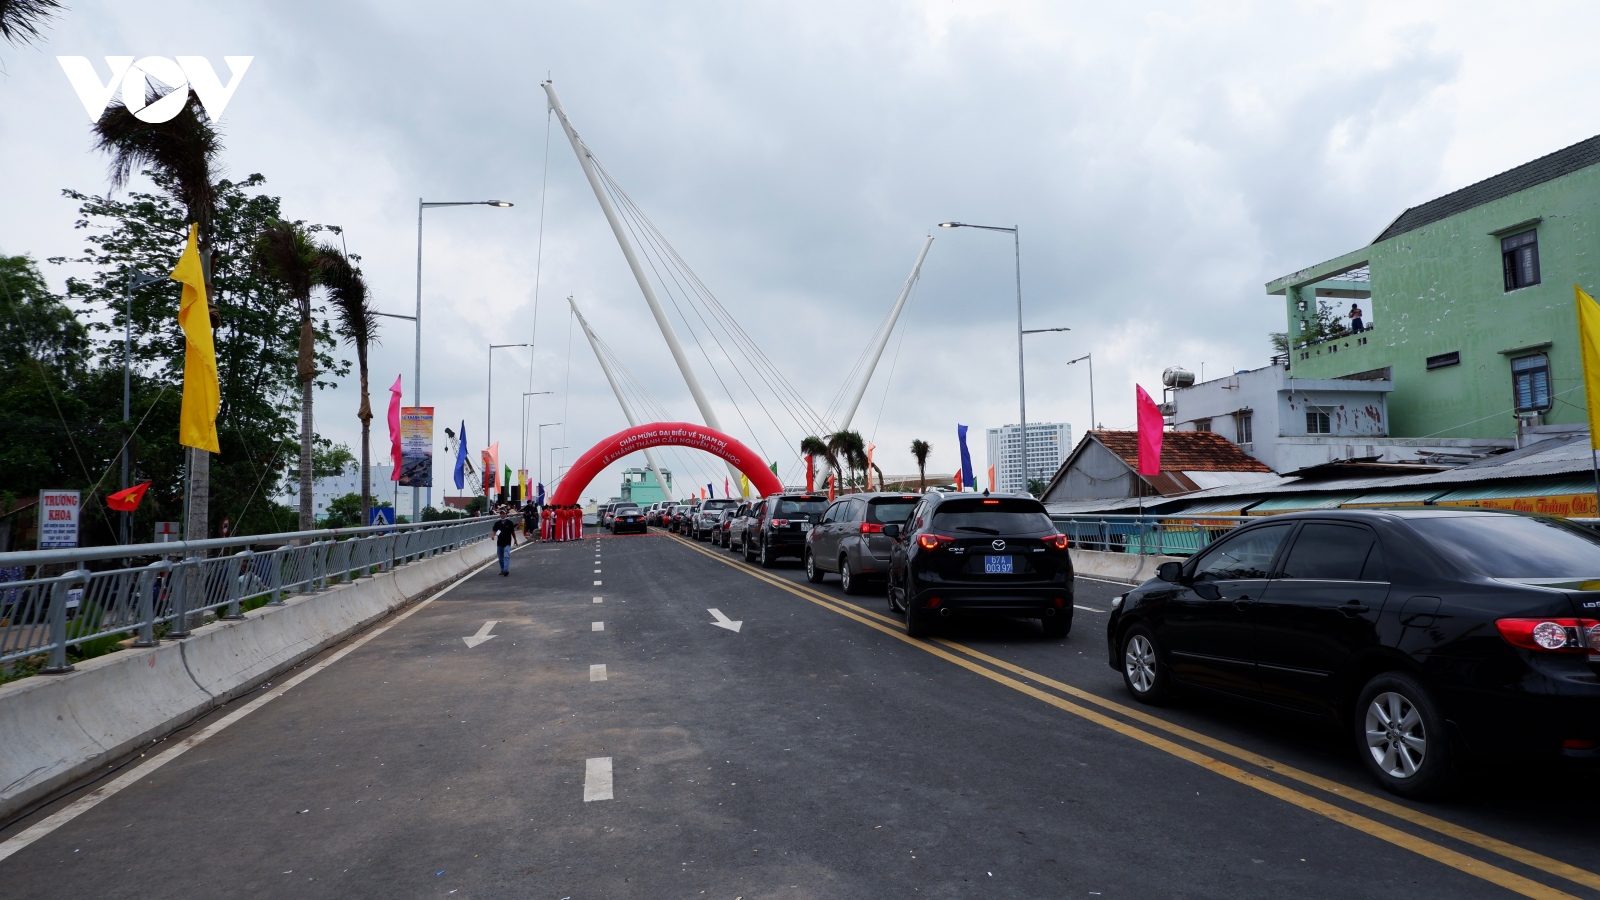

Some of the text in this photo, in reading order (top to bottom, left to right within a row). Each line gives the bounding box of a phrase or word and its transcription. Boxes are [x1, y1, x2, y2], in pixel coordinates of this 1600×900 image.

[620, 435, 637, 447] CHÀO
[637, 431, 658, 440] MỪNG
[672, 428, 687, 436] BIỂU
[699, 433, 717, 444] THAM
[717, 440, 728, 449] DỰ
[602, 454, 611, 465] LỄ
[610, 443, 636, 459] KHÁNH
[636, 437, 660, 448] THÀNH
[661, 435, 678, 443] CẦU
[680, 437, 709, 448] NGUYỄN
[710, 444, 726, 457] THÁI
[48, 510, 72, 520] KHOA
